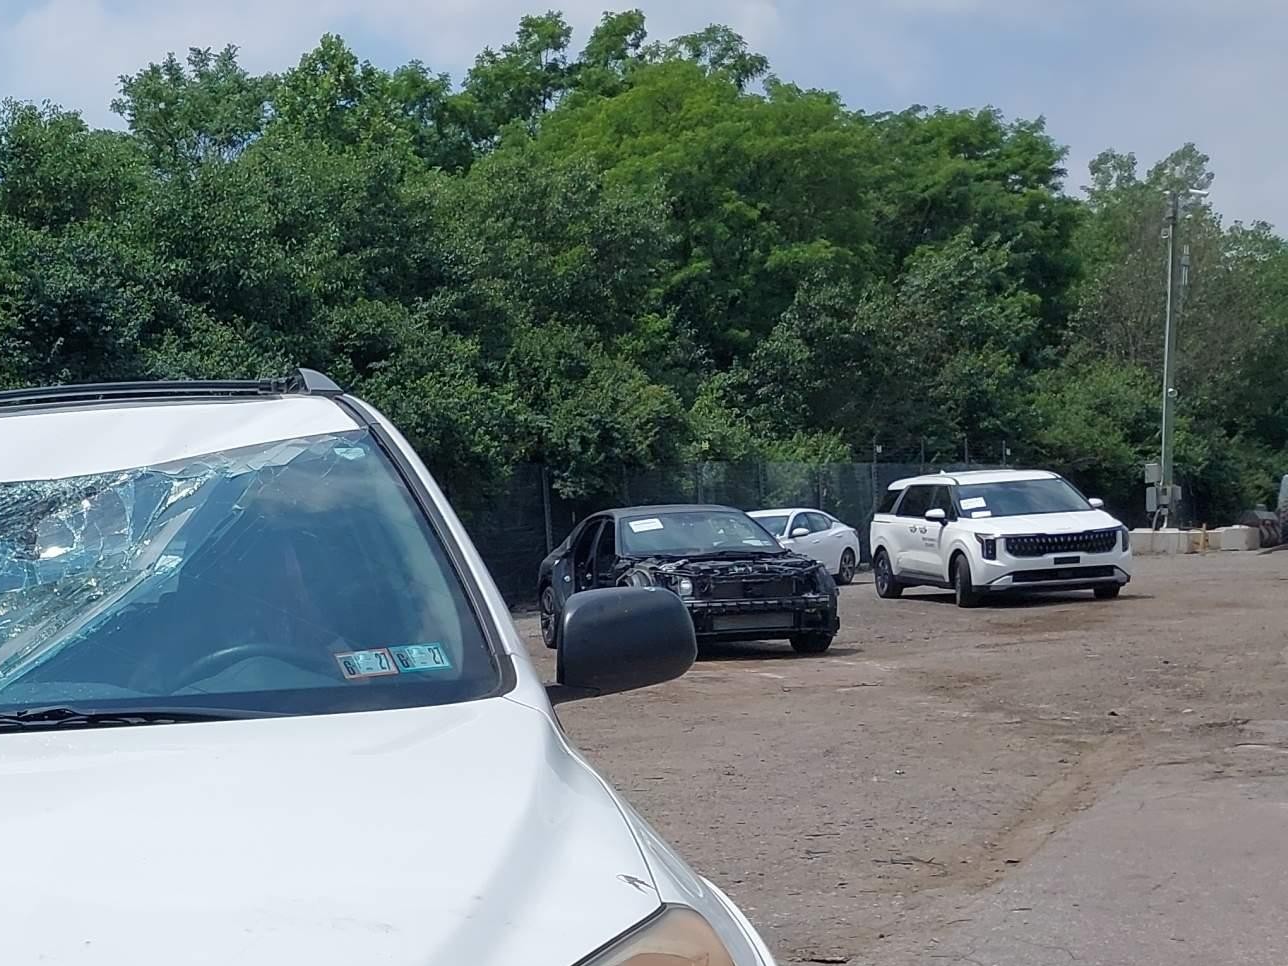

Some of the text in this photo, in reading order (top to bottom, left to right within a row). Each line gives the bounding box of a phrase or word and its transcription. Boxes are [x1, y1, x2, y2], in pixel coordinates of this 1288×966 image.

[343, 652, 391, 676] 6 27
[396, 647, 445, 669] 6 27
